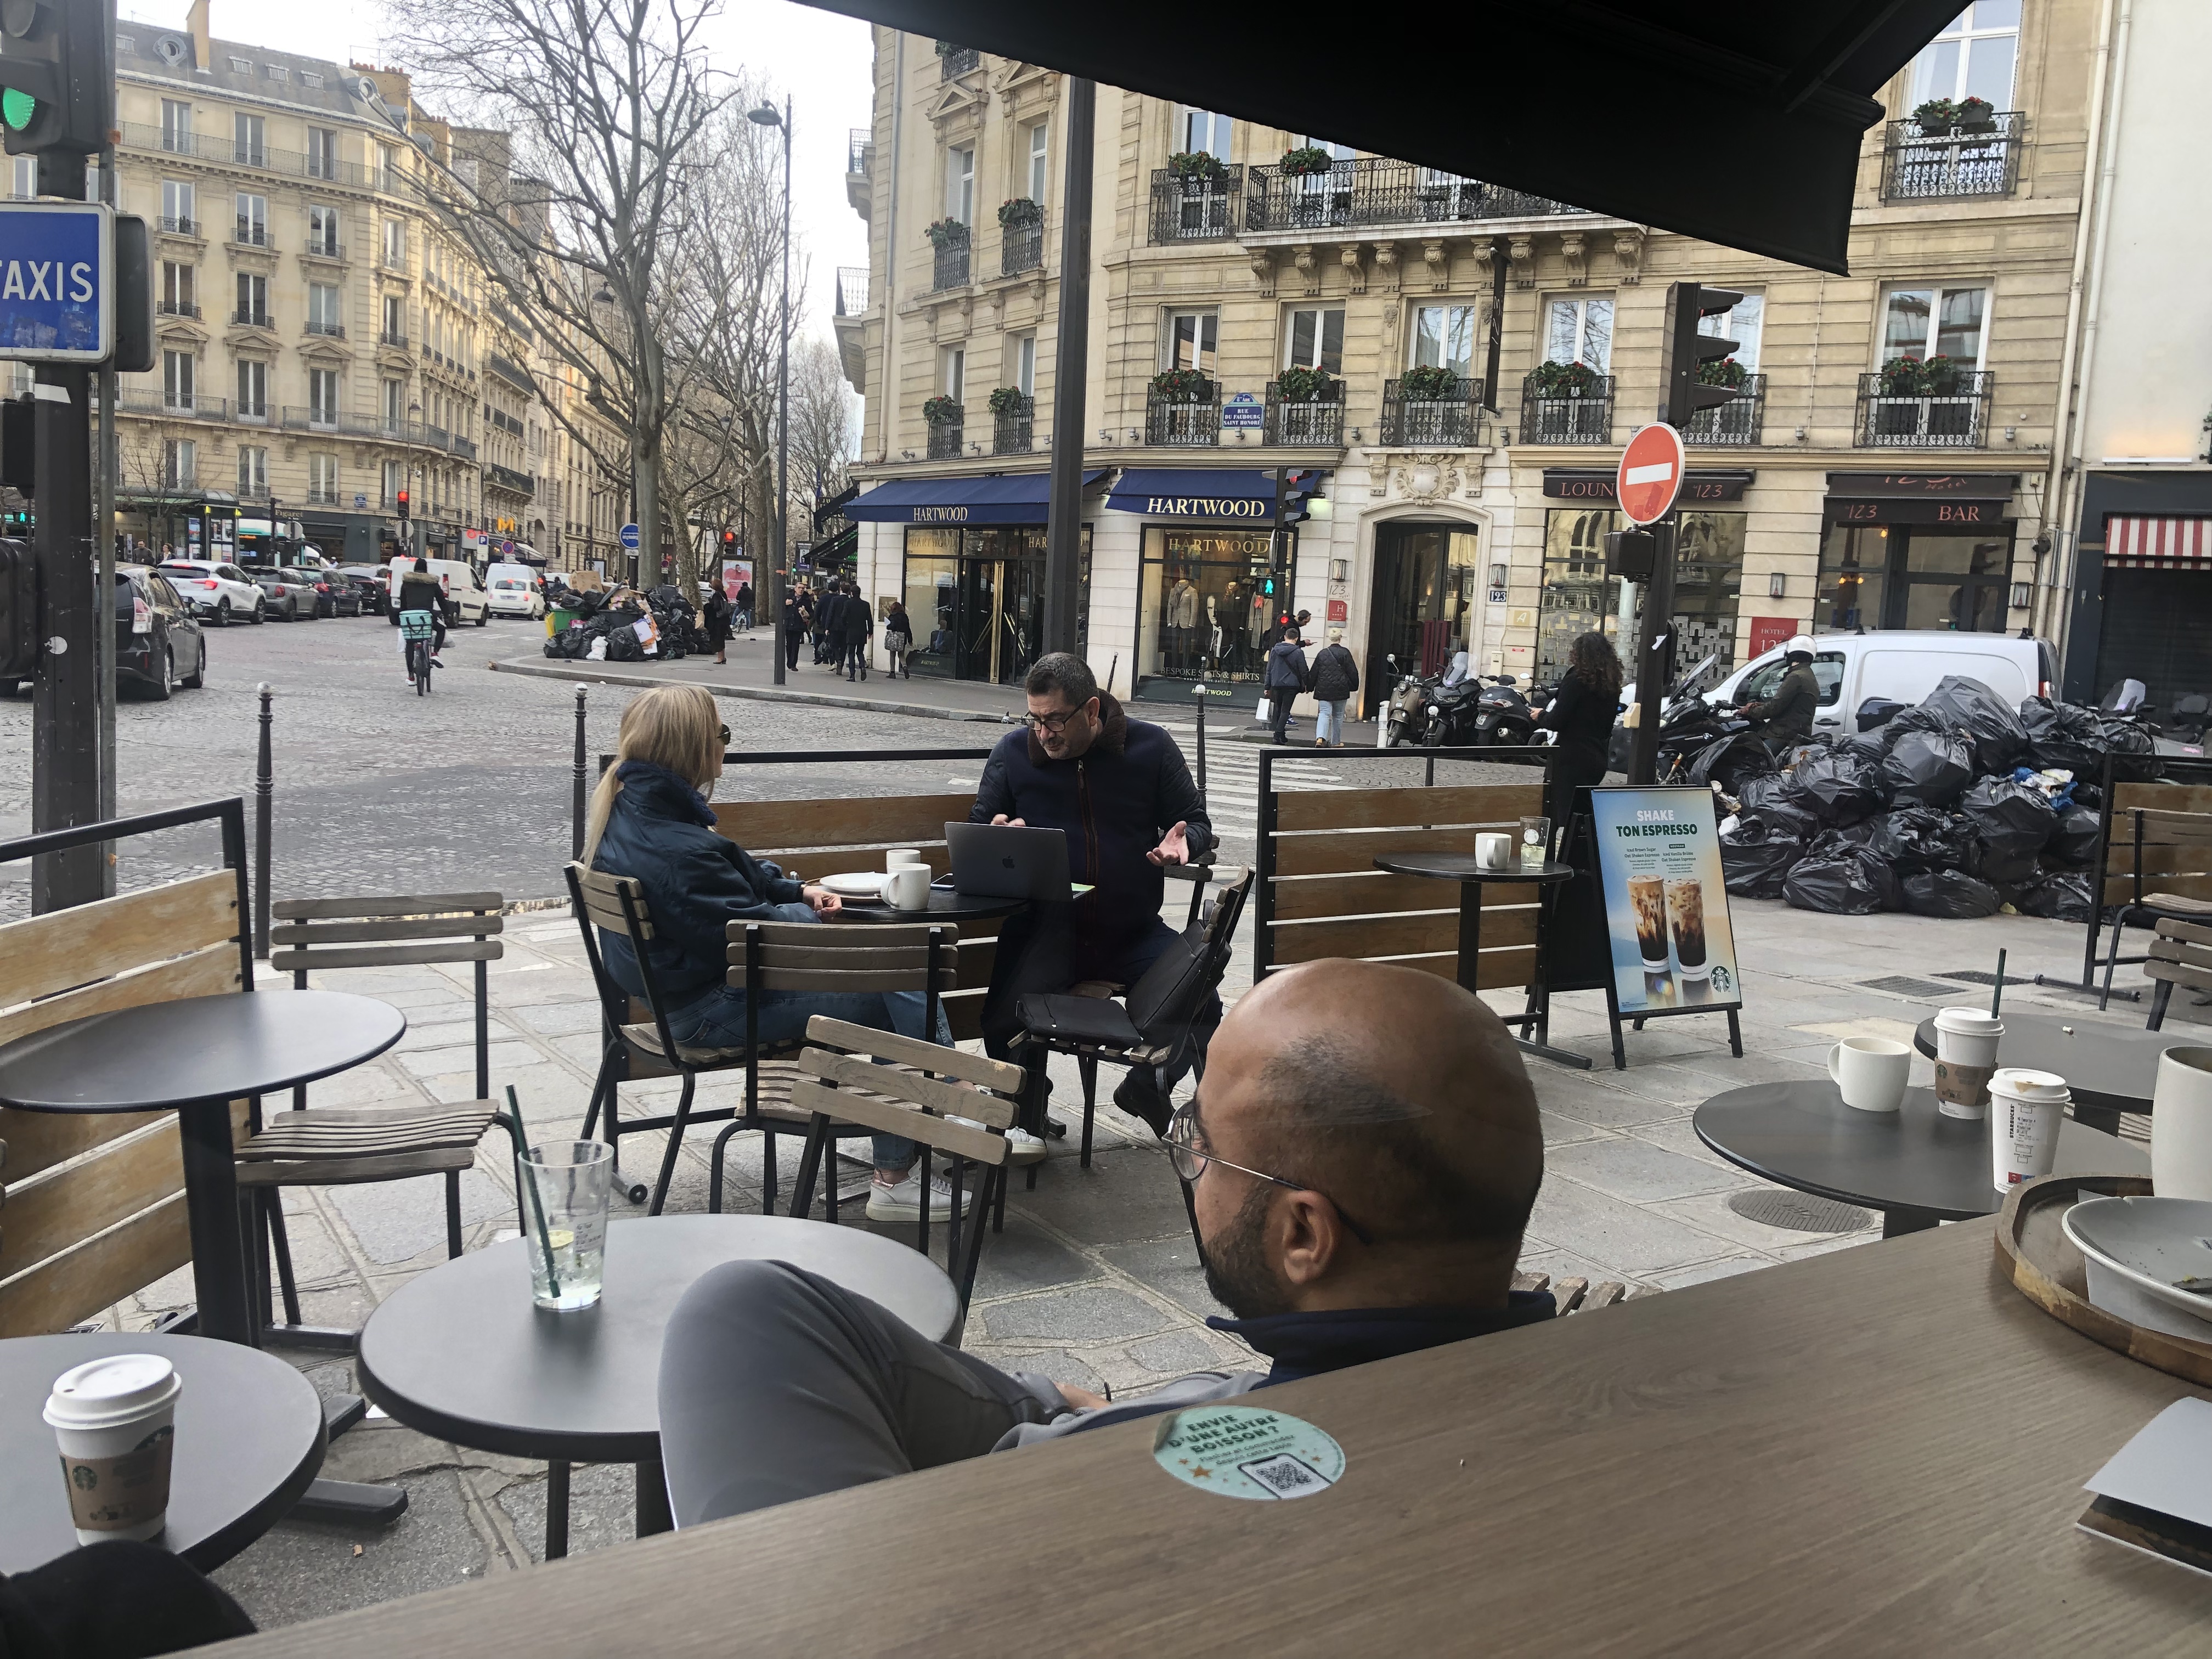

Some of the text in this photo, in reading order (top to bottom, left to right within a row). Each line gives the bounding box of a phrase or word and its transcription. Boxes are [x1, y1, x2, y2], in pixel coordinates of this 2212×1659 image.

[0, 260, 93, 302] AXIS
[1560, 482, 1614, 496] LOUN
[913, 507, 968, 521] HARTWOOD
[1147, 498, 1265, 517] HARTWOOD
[1938, 506, 1980, 521] BAR
[498, 517, 515, 532] M
[1169, 538, 1268, 554] HARTWOOD
[1329, 585, 1346, 595] 123
[1490, 591, 1506, 601] 123
[1760, 639, 1782, 652] 12
[1160, 667, 1196, 676] BESPOKE
[1198, 670, 1221, 678] STS
[1231, 672, 1260, 681] SHIRTS
[1190, 688, 1232, 696] HTWOOD
[1637, 810, 1674, 821] SHAKE
[1616, 824, 1697, 837] TON ESPRESSO
[1186, 1414, 1237, 1431] ENVIE
[1168, 1415, 1279, 1448] D'UNE AUTRE
[1189, 1429, 1269, 1454] BOISSON
